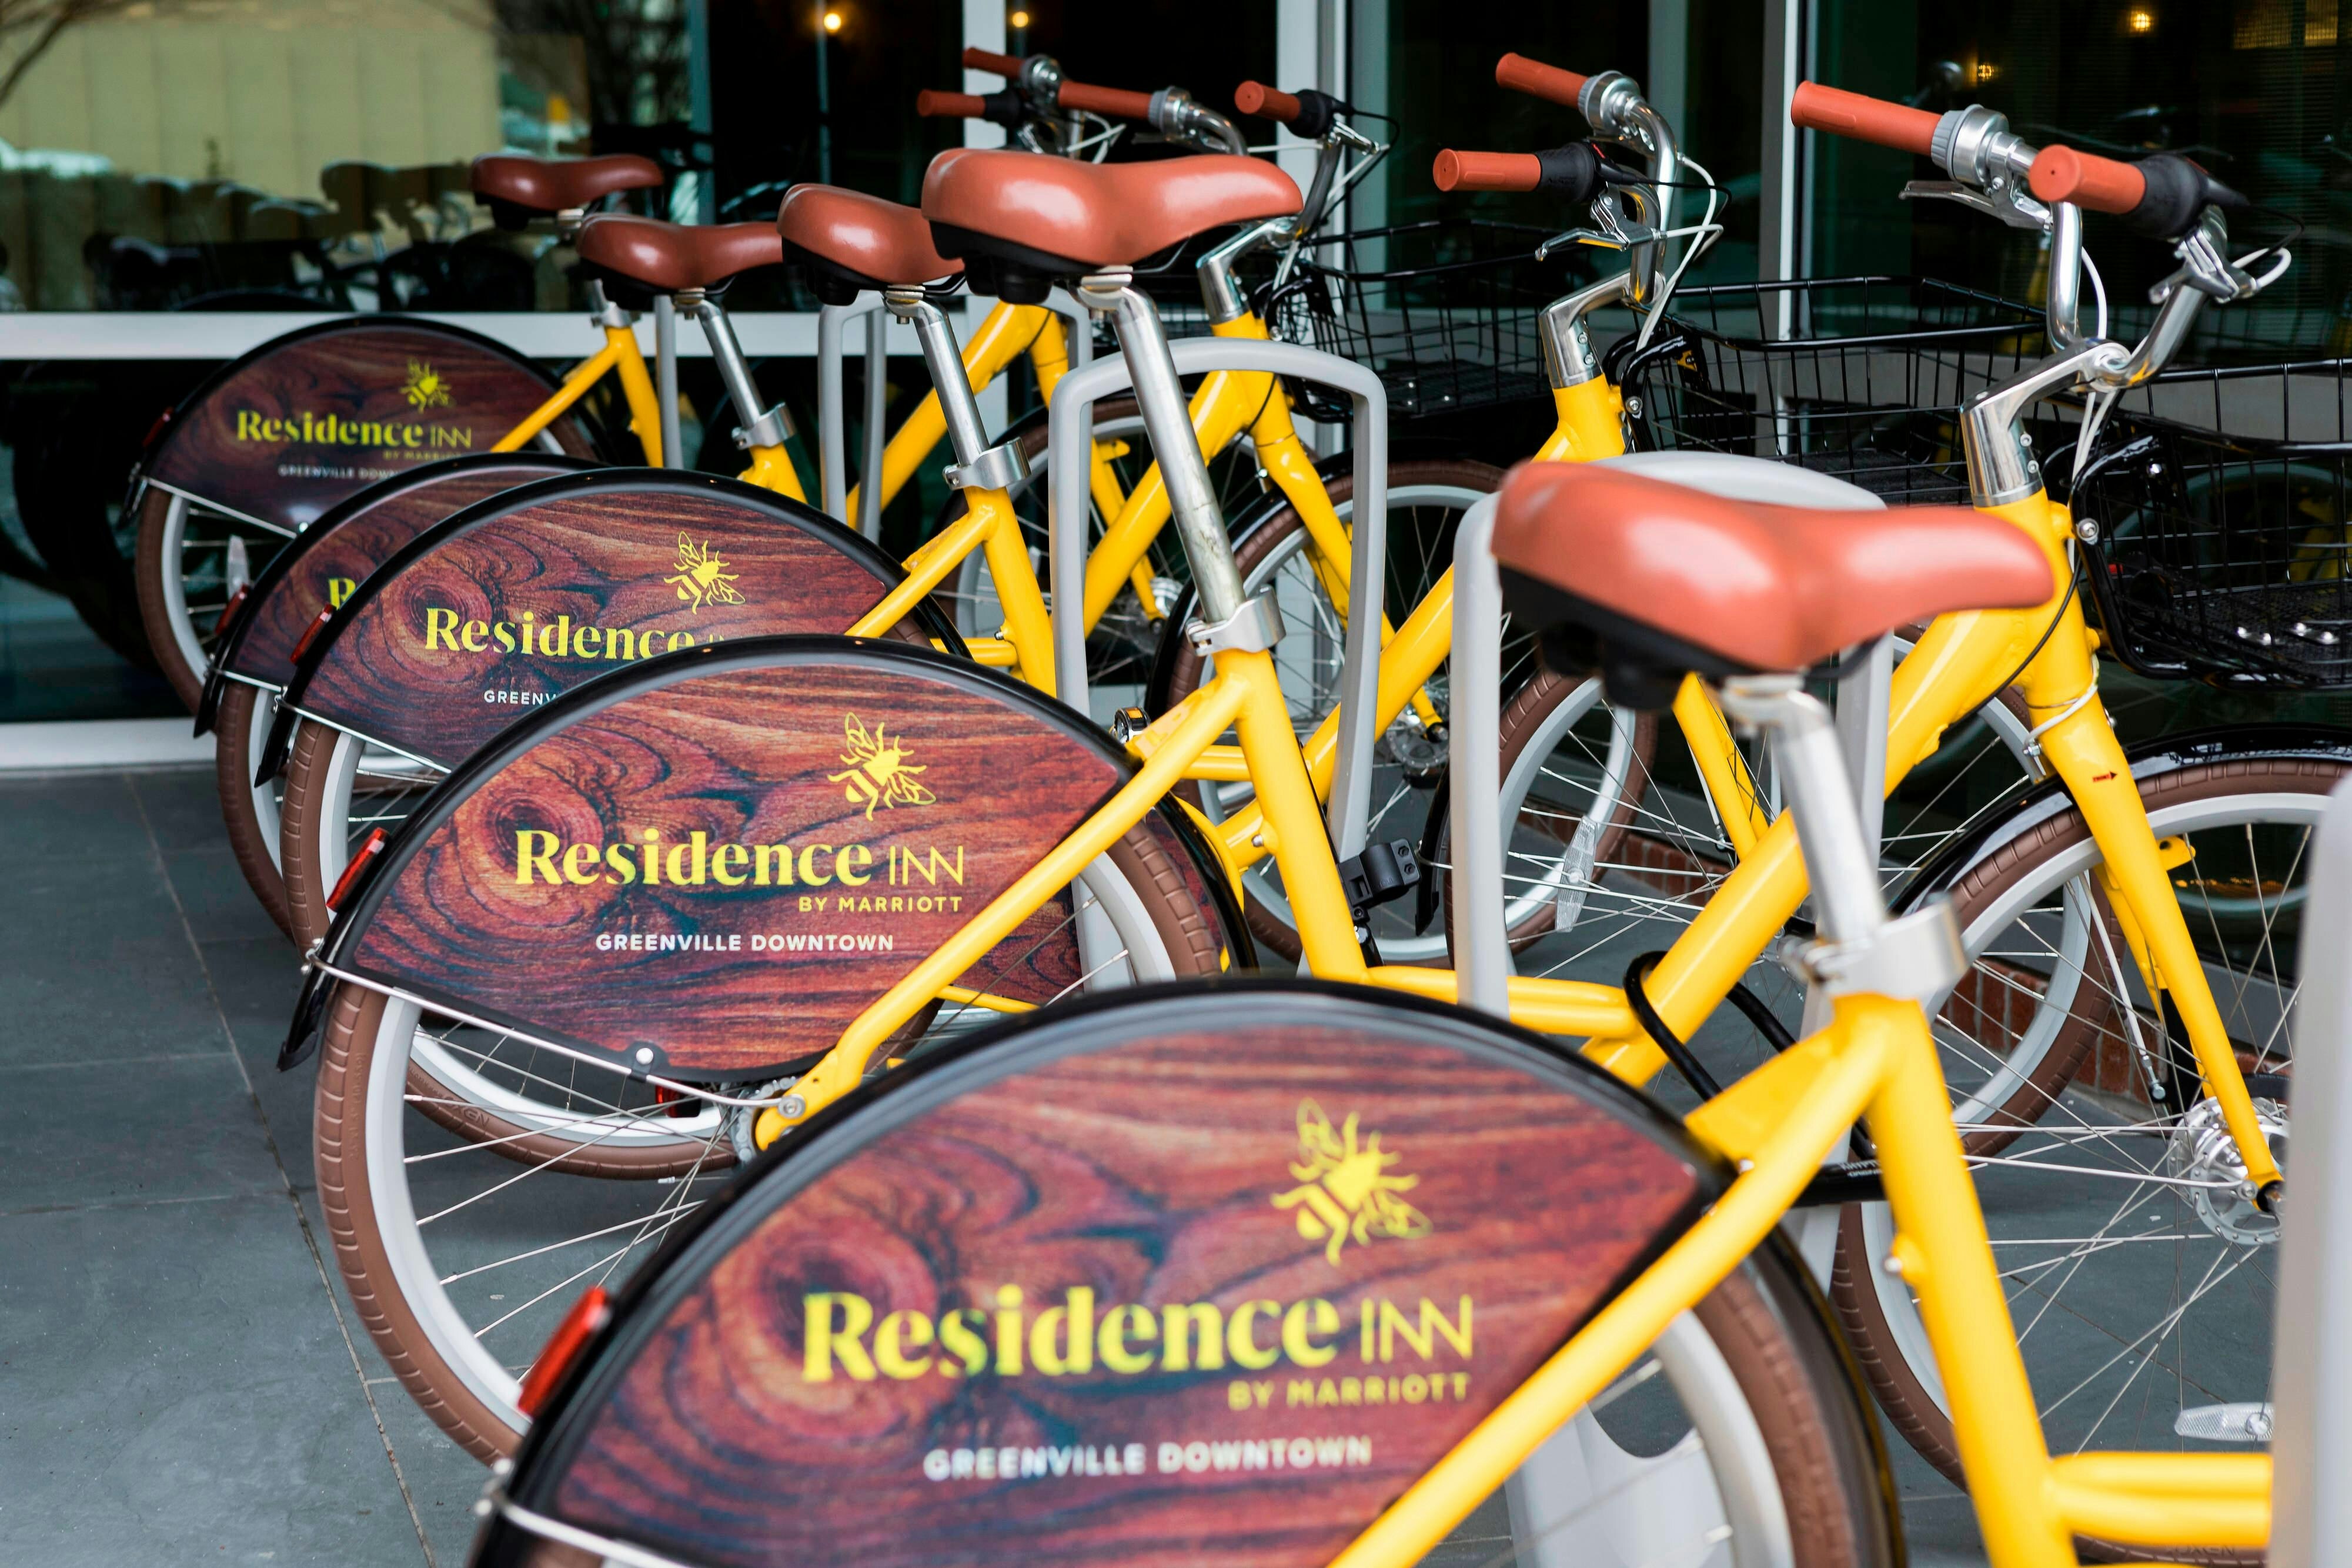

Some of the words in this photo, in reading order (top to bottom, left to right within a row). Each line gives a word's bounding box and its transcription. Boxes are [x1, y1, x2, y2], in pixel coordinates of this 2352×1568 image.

[238, 410, 423, 447] Residence
[430, 426, 472, 449] INN
[426, 608, 694, 660] Residence
[515, 827, 873, 887] Residence
[888, 845, 964, 886] INN
[799, 897, 827, 912] BY
[838, 896, 962, 913] MARRIOTT
[595, 934, 741, 952] GREENVILLE
[751, 934, 894, 952] DOWNTOWN
[802, 1283, 1341, 1383] Residence
[1361, 1293, 1474, 1363] INN
[1228, 1380, 1274, 1410] BY
[1287, 1371, 1471, 1406] MARRIOTT
[923, 1442, 1146, 1482] GREENVILLE
[1157, 1436, 1372, 1474] DOWNTOWN
